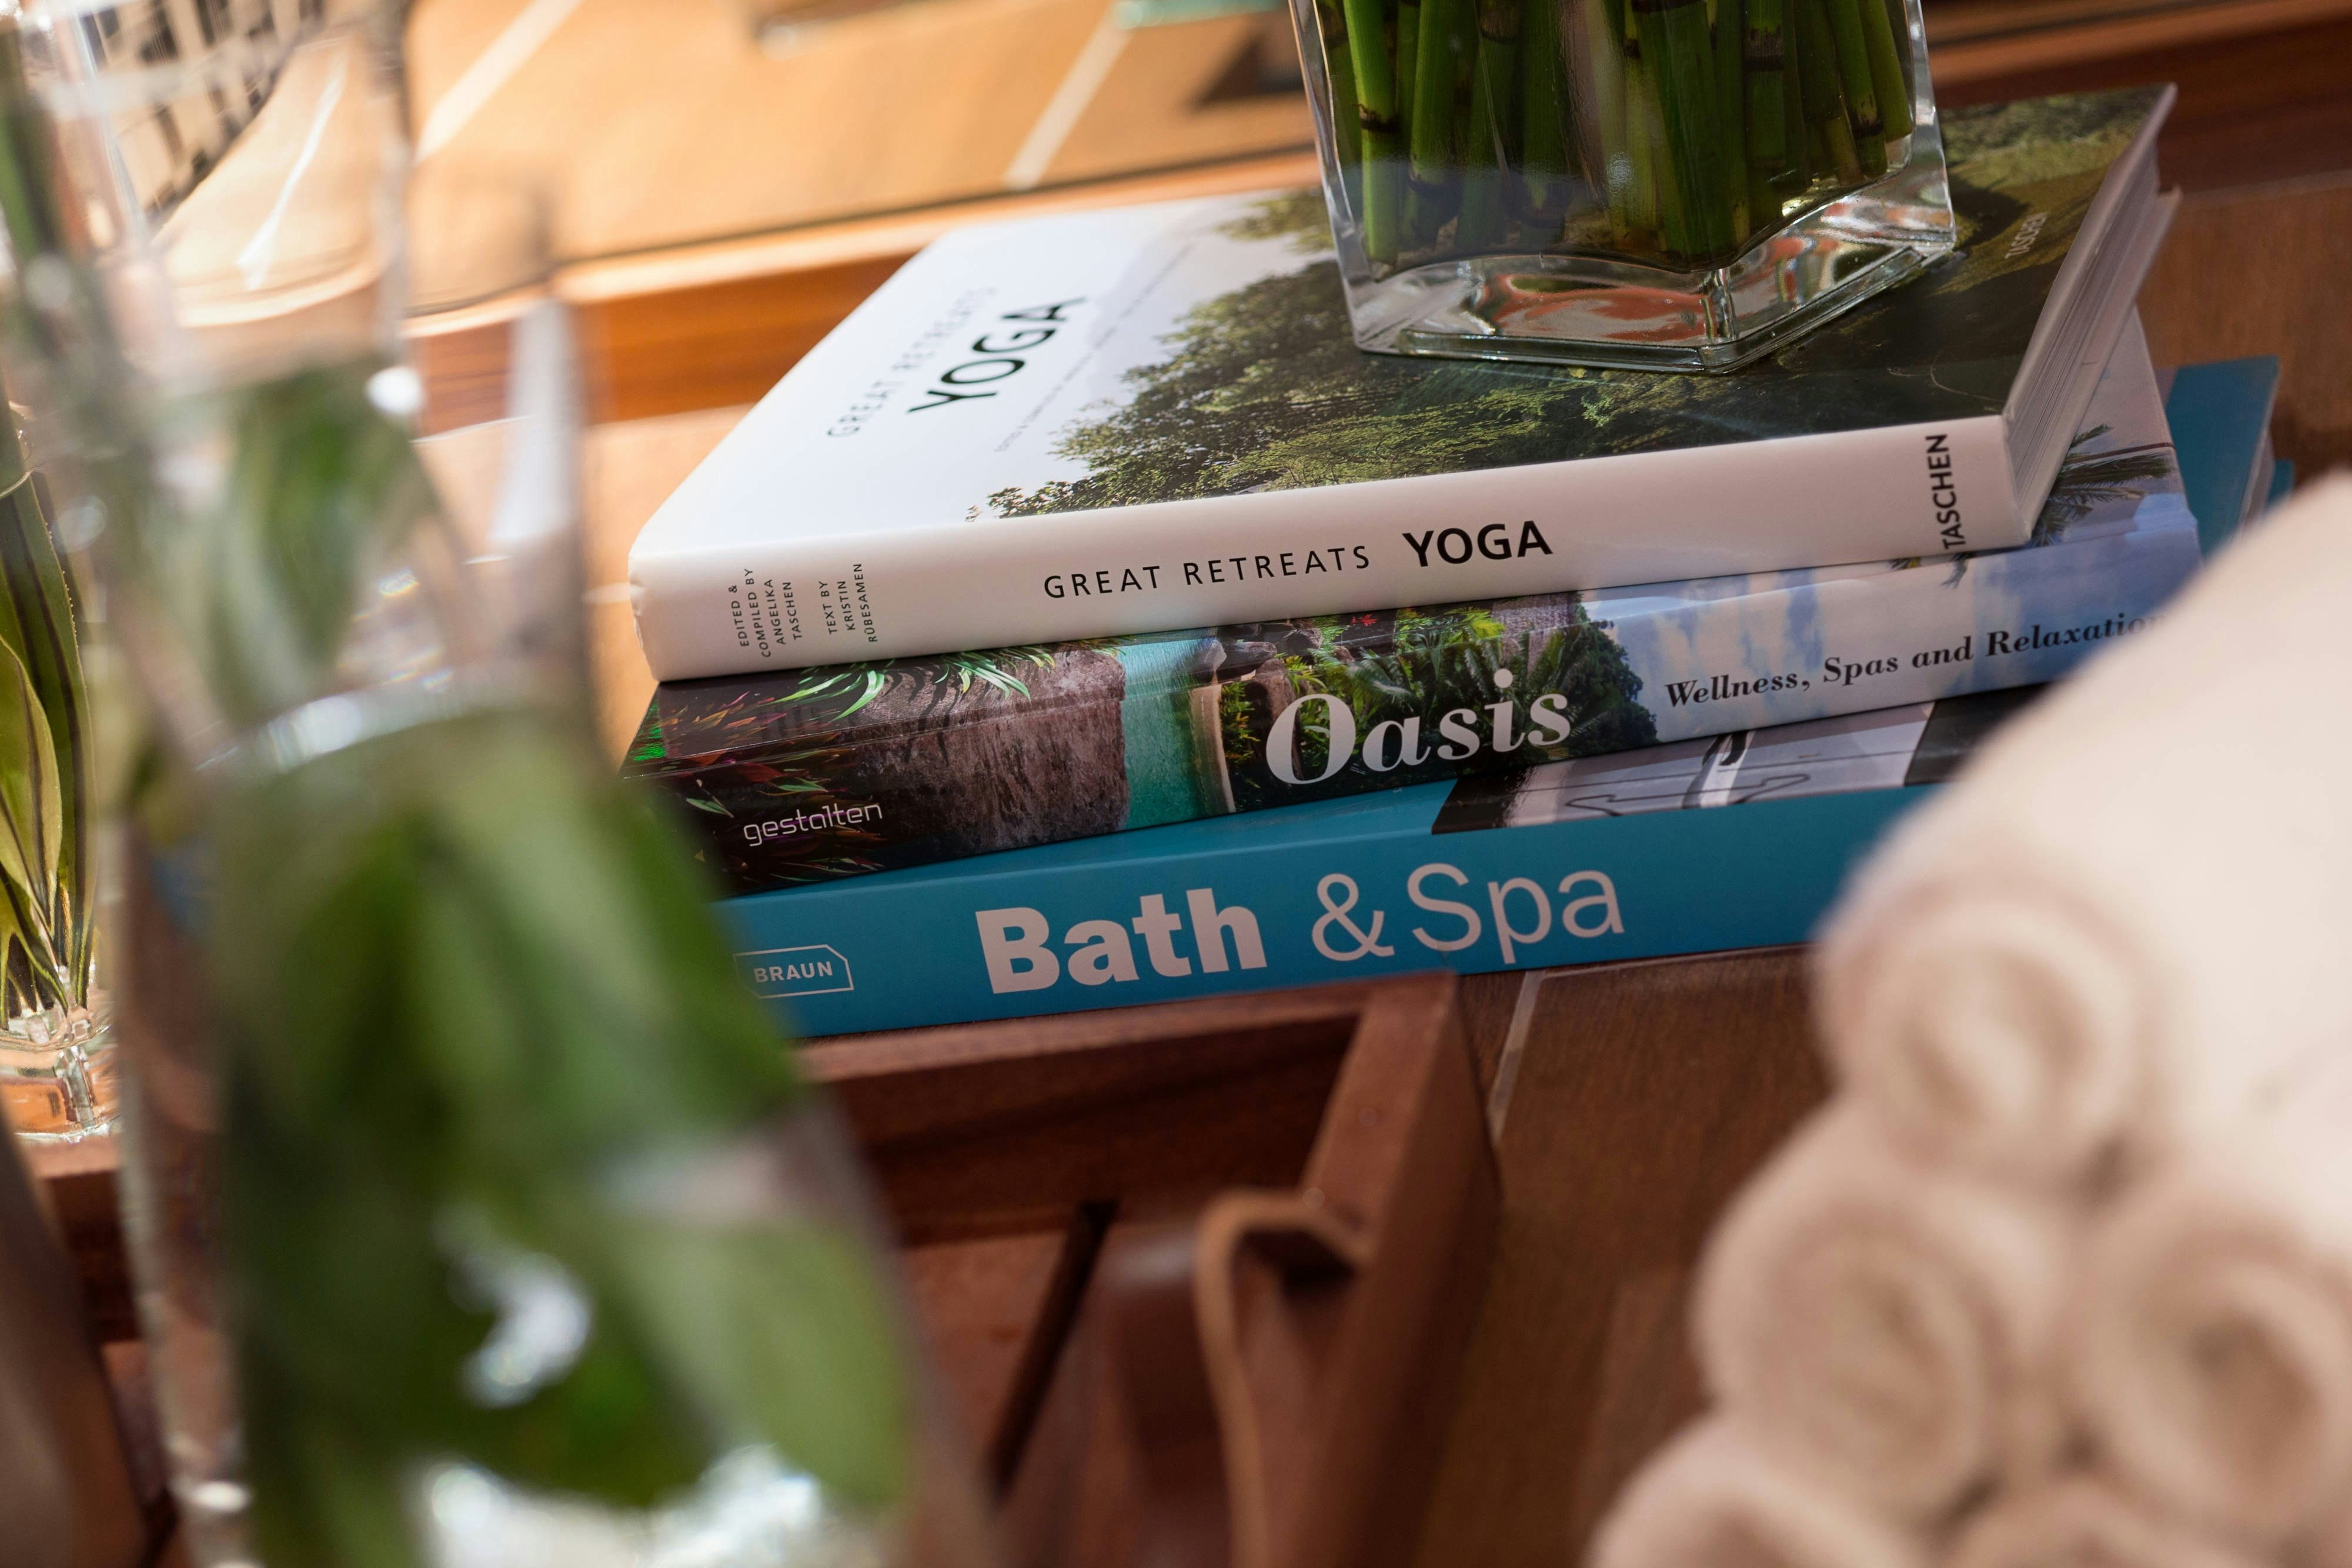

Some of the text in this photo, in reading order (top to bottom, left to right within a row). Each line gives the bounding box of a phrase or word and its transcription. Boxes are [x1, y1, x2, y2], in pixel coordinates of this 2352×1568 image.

[906, 296, 1087, 413] YOGA
[1925, 434, 1966, 549] TASCHEN
[1044, 520, 1553, 599] GREAT RETREATS YOGA
[728, 585, 750, 647] EDITED &
[744, 569, 771, 658] COMPILED BY
[764, 579, 786, 645] ANGELIKA
[783, 582, 803, 640] TASCHEN
[818, 581, 838, 635] TEXT BY
[837, 581, 856, 631] KRISTIN
[1665, 673, 1811, 707] Wellness,
[1823, 657, 1899, 686] Spas
[1912, 636, 1974, 668] and
[1265, 668, 1571, 785] Oasis
[743, 803, 883, 847] gestalten
[975, 863, 1625, 994] Bath & Spa
[753, 961, 833, 982] BRAUN
